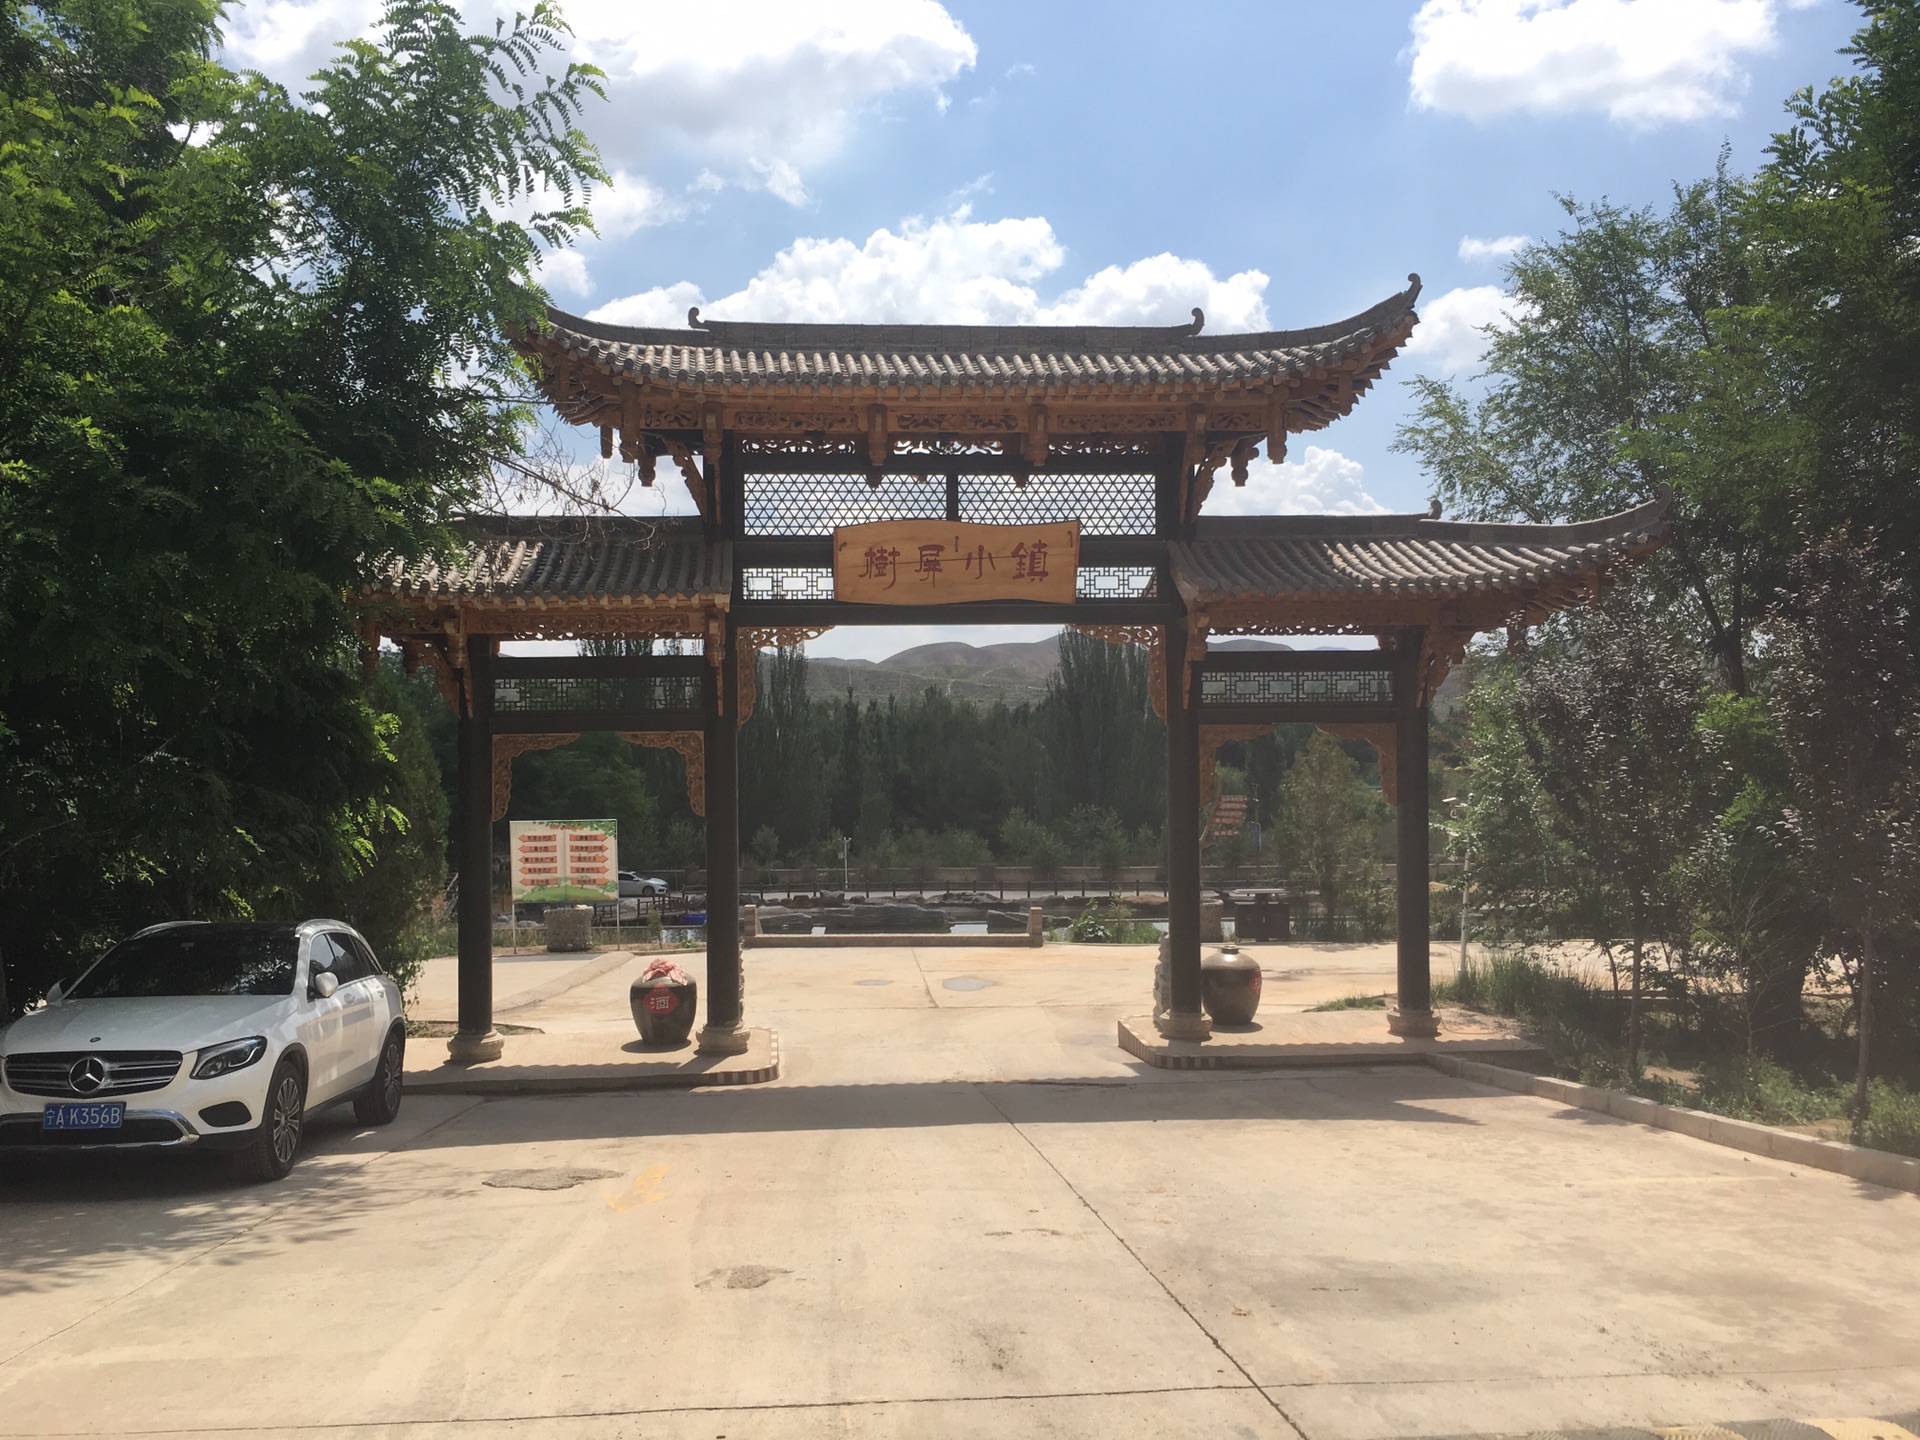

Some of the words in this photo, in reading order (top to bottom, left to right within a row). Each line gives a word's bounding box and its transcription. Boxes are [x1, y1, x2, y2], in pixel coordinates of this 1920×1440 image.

[858, 539, 1050, 591] 樹屏小鎮
[650, 996, 671, 1010] 酒
